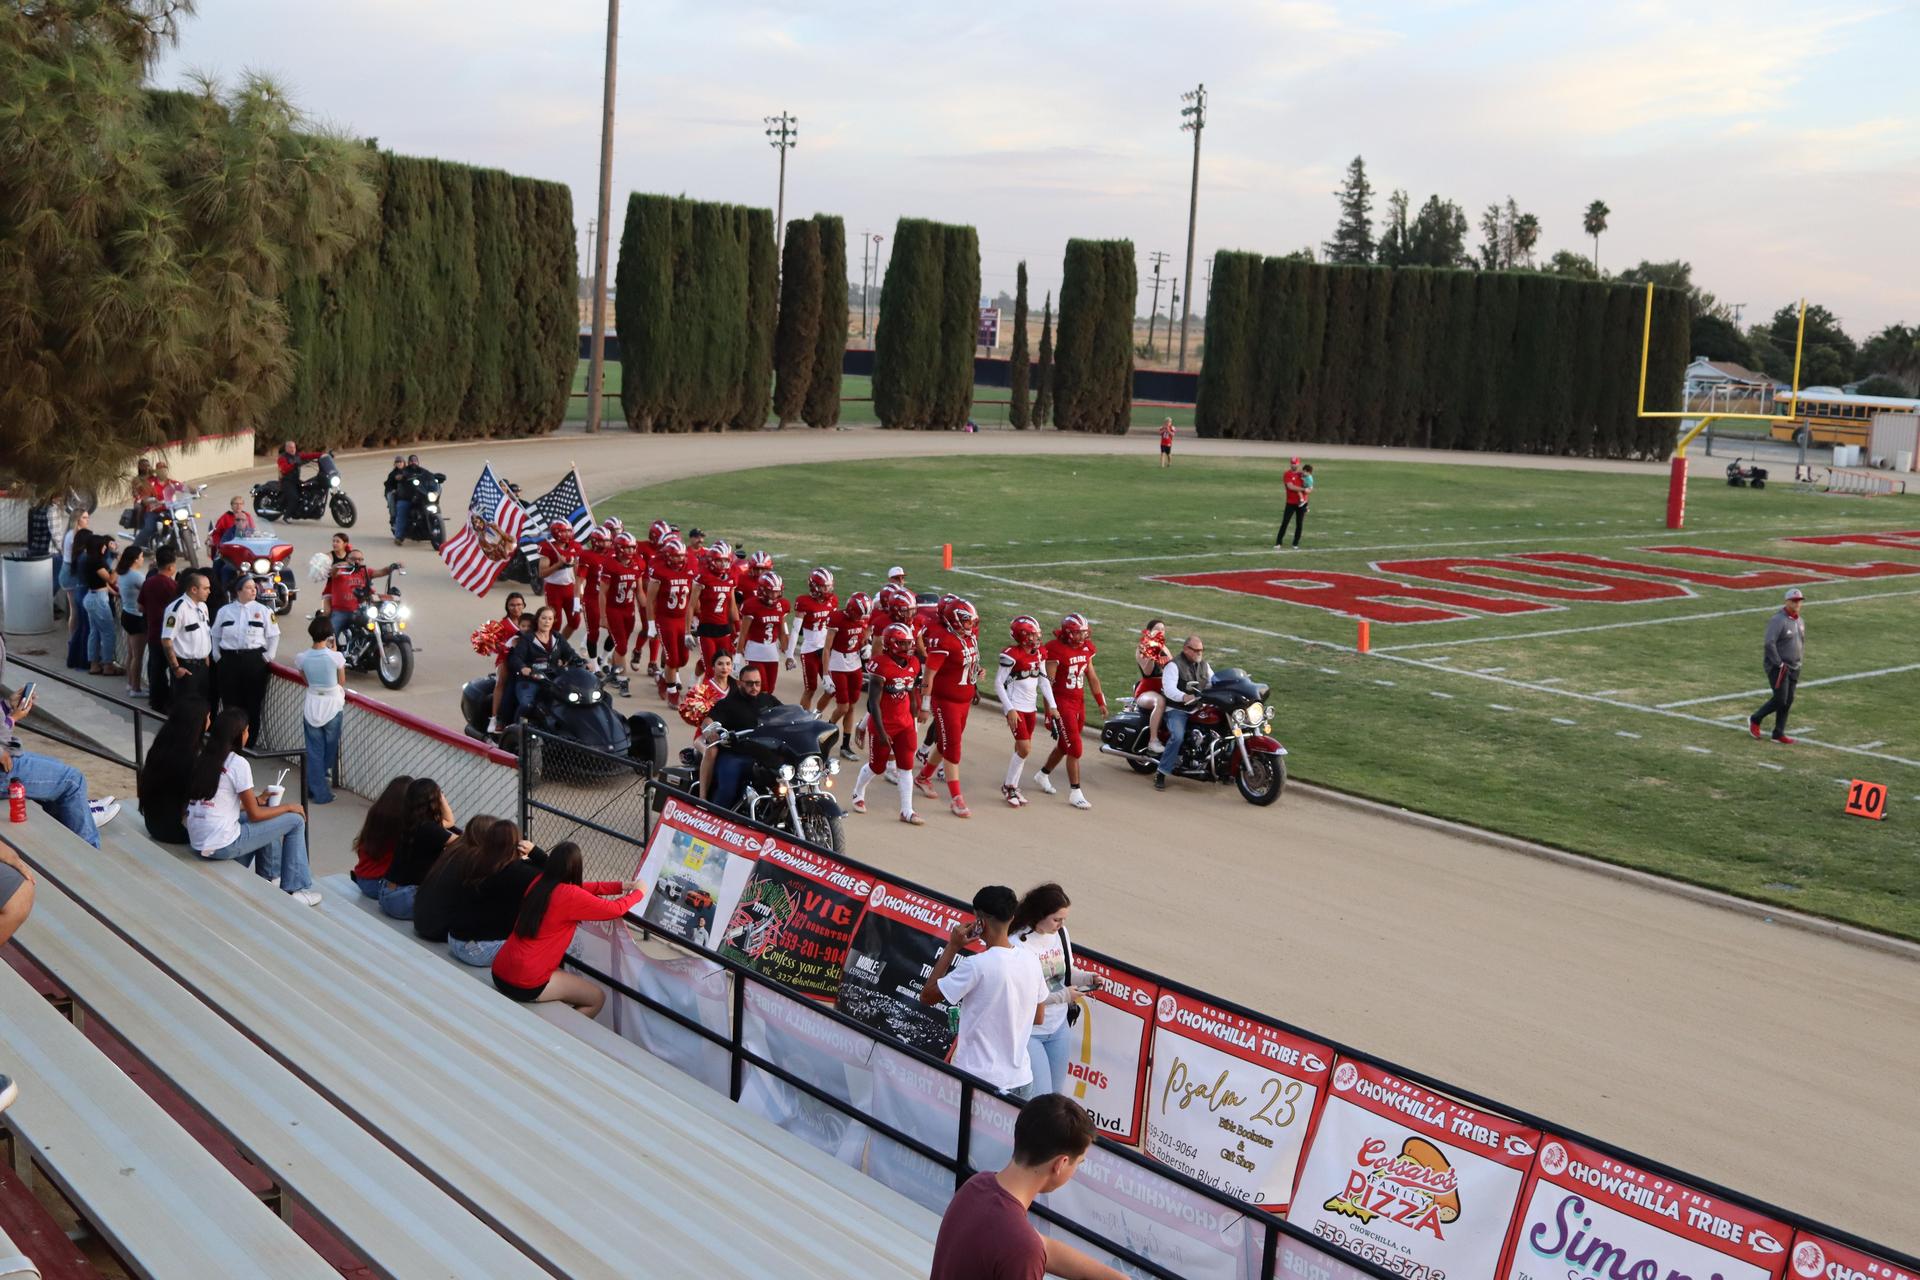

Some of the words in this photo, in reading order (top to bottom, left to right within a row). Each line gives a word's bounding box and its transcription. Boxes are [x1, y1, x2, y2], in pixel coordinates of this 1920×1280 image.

[667, 586, 689, 609] 53
[714, 592, 726, 613] 2
[1849, 784, 1880, 813] 10
[672, 809, 720, 837] CHOWCHILLA
[720, 829, 745, 847] TRIBE
[771, 847, 827, 878] CHOWCHILLA
[826, 871, 855, 891] TRIBE
[791, 846, 813, 861] HOME
[803, 890, 853, 926] VIC
[884, 895, 943, 928] CHOWCHILLA
[905, 893, 929, 906] HOME
[945, 908, 962, 919] THE
[762, 945, 796, 970] Confess
[799, 961, 822, 977] your
[1093, 963, 1110, 976] THE
[1176, 1009, 1256, 1051] CHOWCHILLA
[1261, 1039, 1299, 1067] TRIBE
[1203, 1006, 1232, 1023] HOME
[1239, 1020, 1251, 1030] OF
[1257, 1026, 1278, 1039] THE
[1161, 1056, 1248, 1116] Psalm
[1249, 1078, 1303, 1128] 23
[1382, 1076, 1420, 1098] HOME
[1427, 1095, 1443, 1107] OF
[1449, 1102, 1475, 1120] THE
[1355, 1078, 1446, 1129] CHOWCHILLA
[1449, 1117, 1500, 1150] TRIBE
[1218, 1116, 1236, 1133] Bible
[1235, 1125, 1273, 1149] Bookstore
[1220, 1149, 1237, 1163] Gift
[1236, 1154, 1255, 1173] Shop
[1224, 1181, 1251, 1203] Suite
[1254, 1192, 1265, 1204] D
[1370, 1176, 1428, 1206] FAMILY
[1602, 1160, 1646, 1183] HOME
[1654, 1181, 1673, 1195] OF
[1682, 1191, 1712, 1209] THE
[1343, 1169, 1446, 1242] PIZZA
[1568, 1160, 1681, 1222] CHOWCHILLA
[1686, 1205, 1744, 1245] TRIBE
[1312, 1219, 1446, 1280] 559-665-5713
[1401, 1245, 1412, 1255] CA
[1868, 1262, 1909, 1280] HOM
